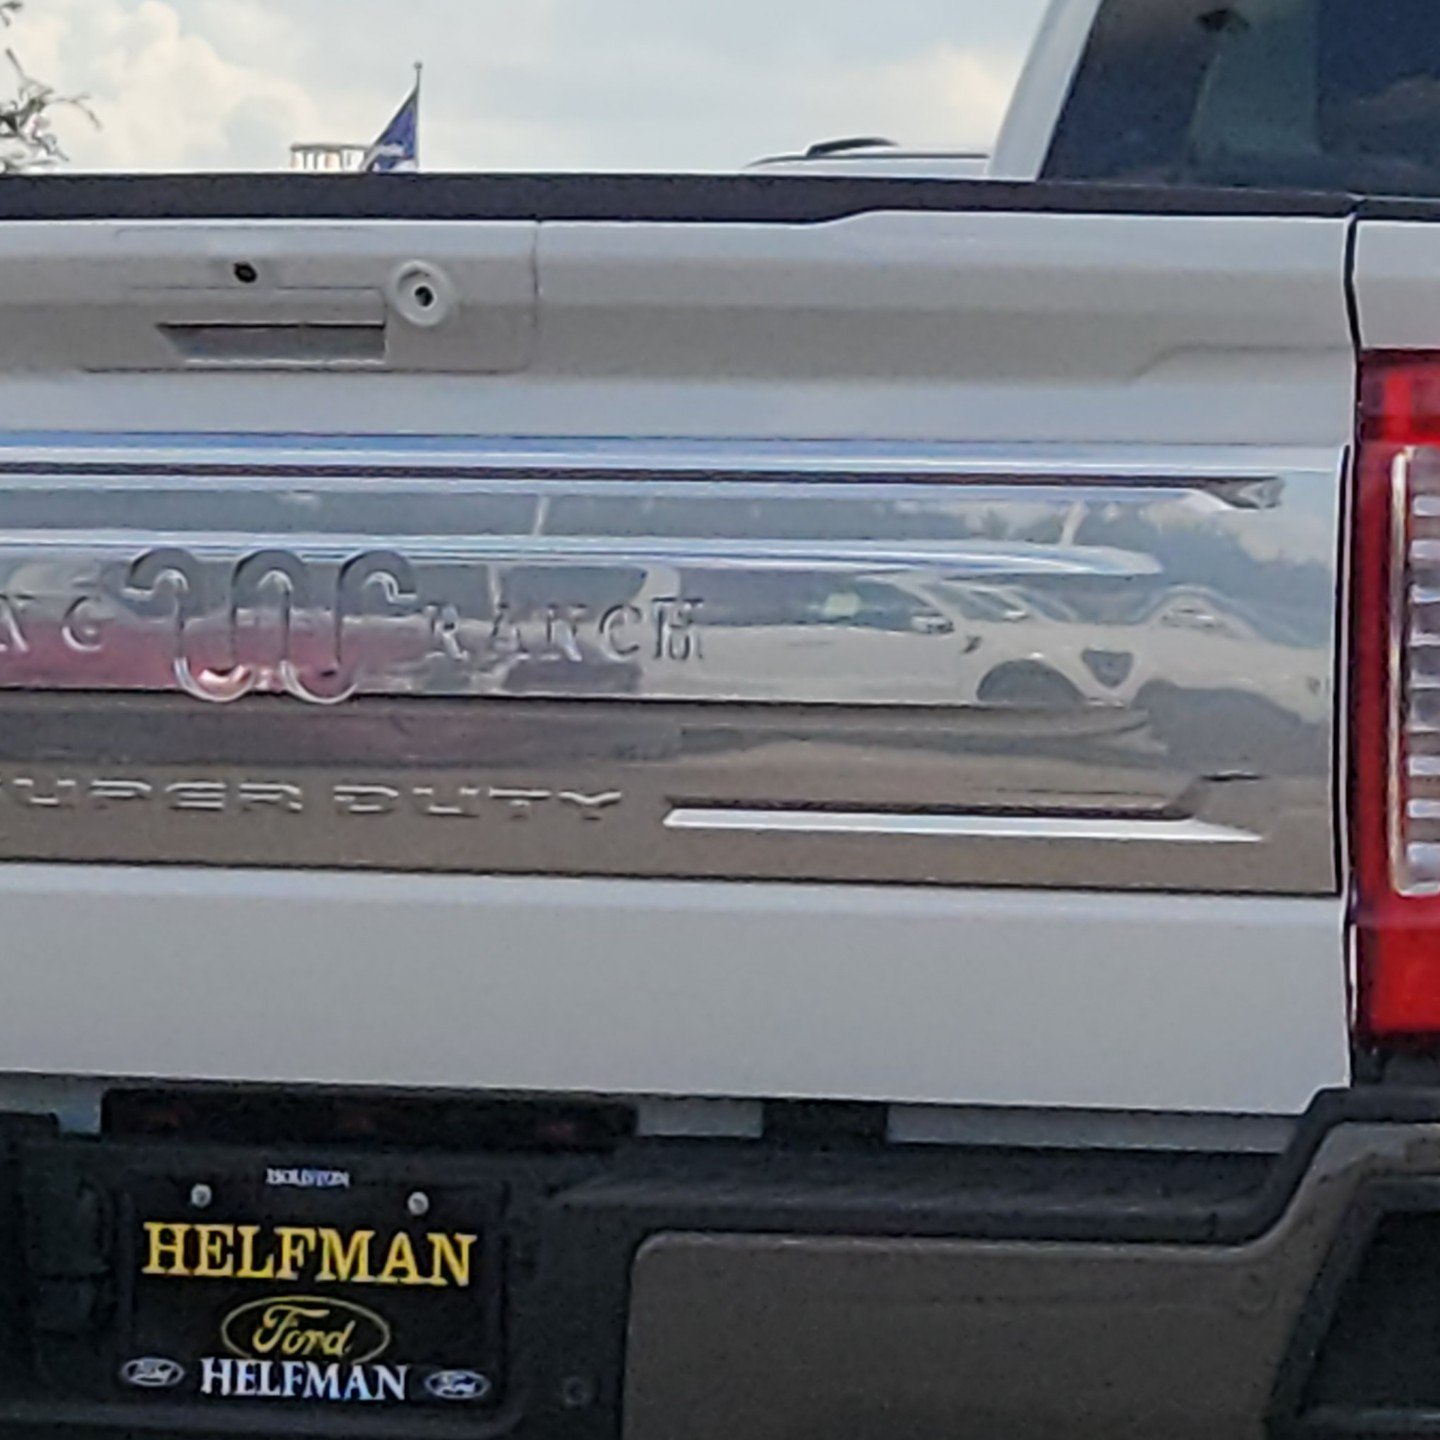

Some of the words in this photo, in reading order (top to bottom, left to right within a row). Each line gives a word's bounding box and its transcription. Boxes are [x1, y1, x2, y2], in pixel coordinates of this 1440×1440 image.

[424, 596, 706, 662] RANCH
[333, 784, 623, 822] DUTY
[142, 1221, 477, 1287] HELFMAN
[252, 1304, 356, 1357] Ford
[200, 1358, 409, 1400] HELFMAN
